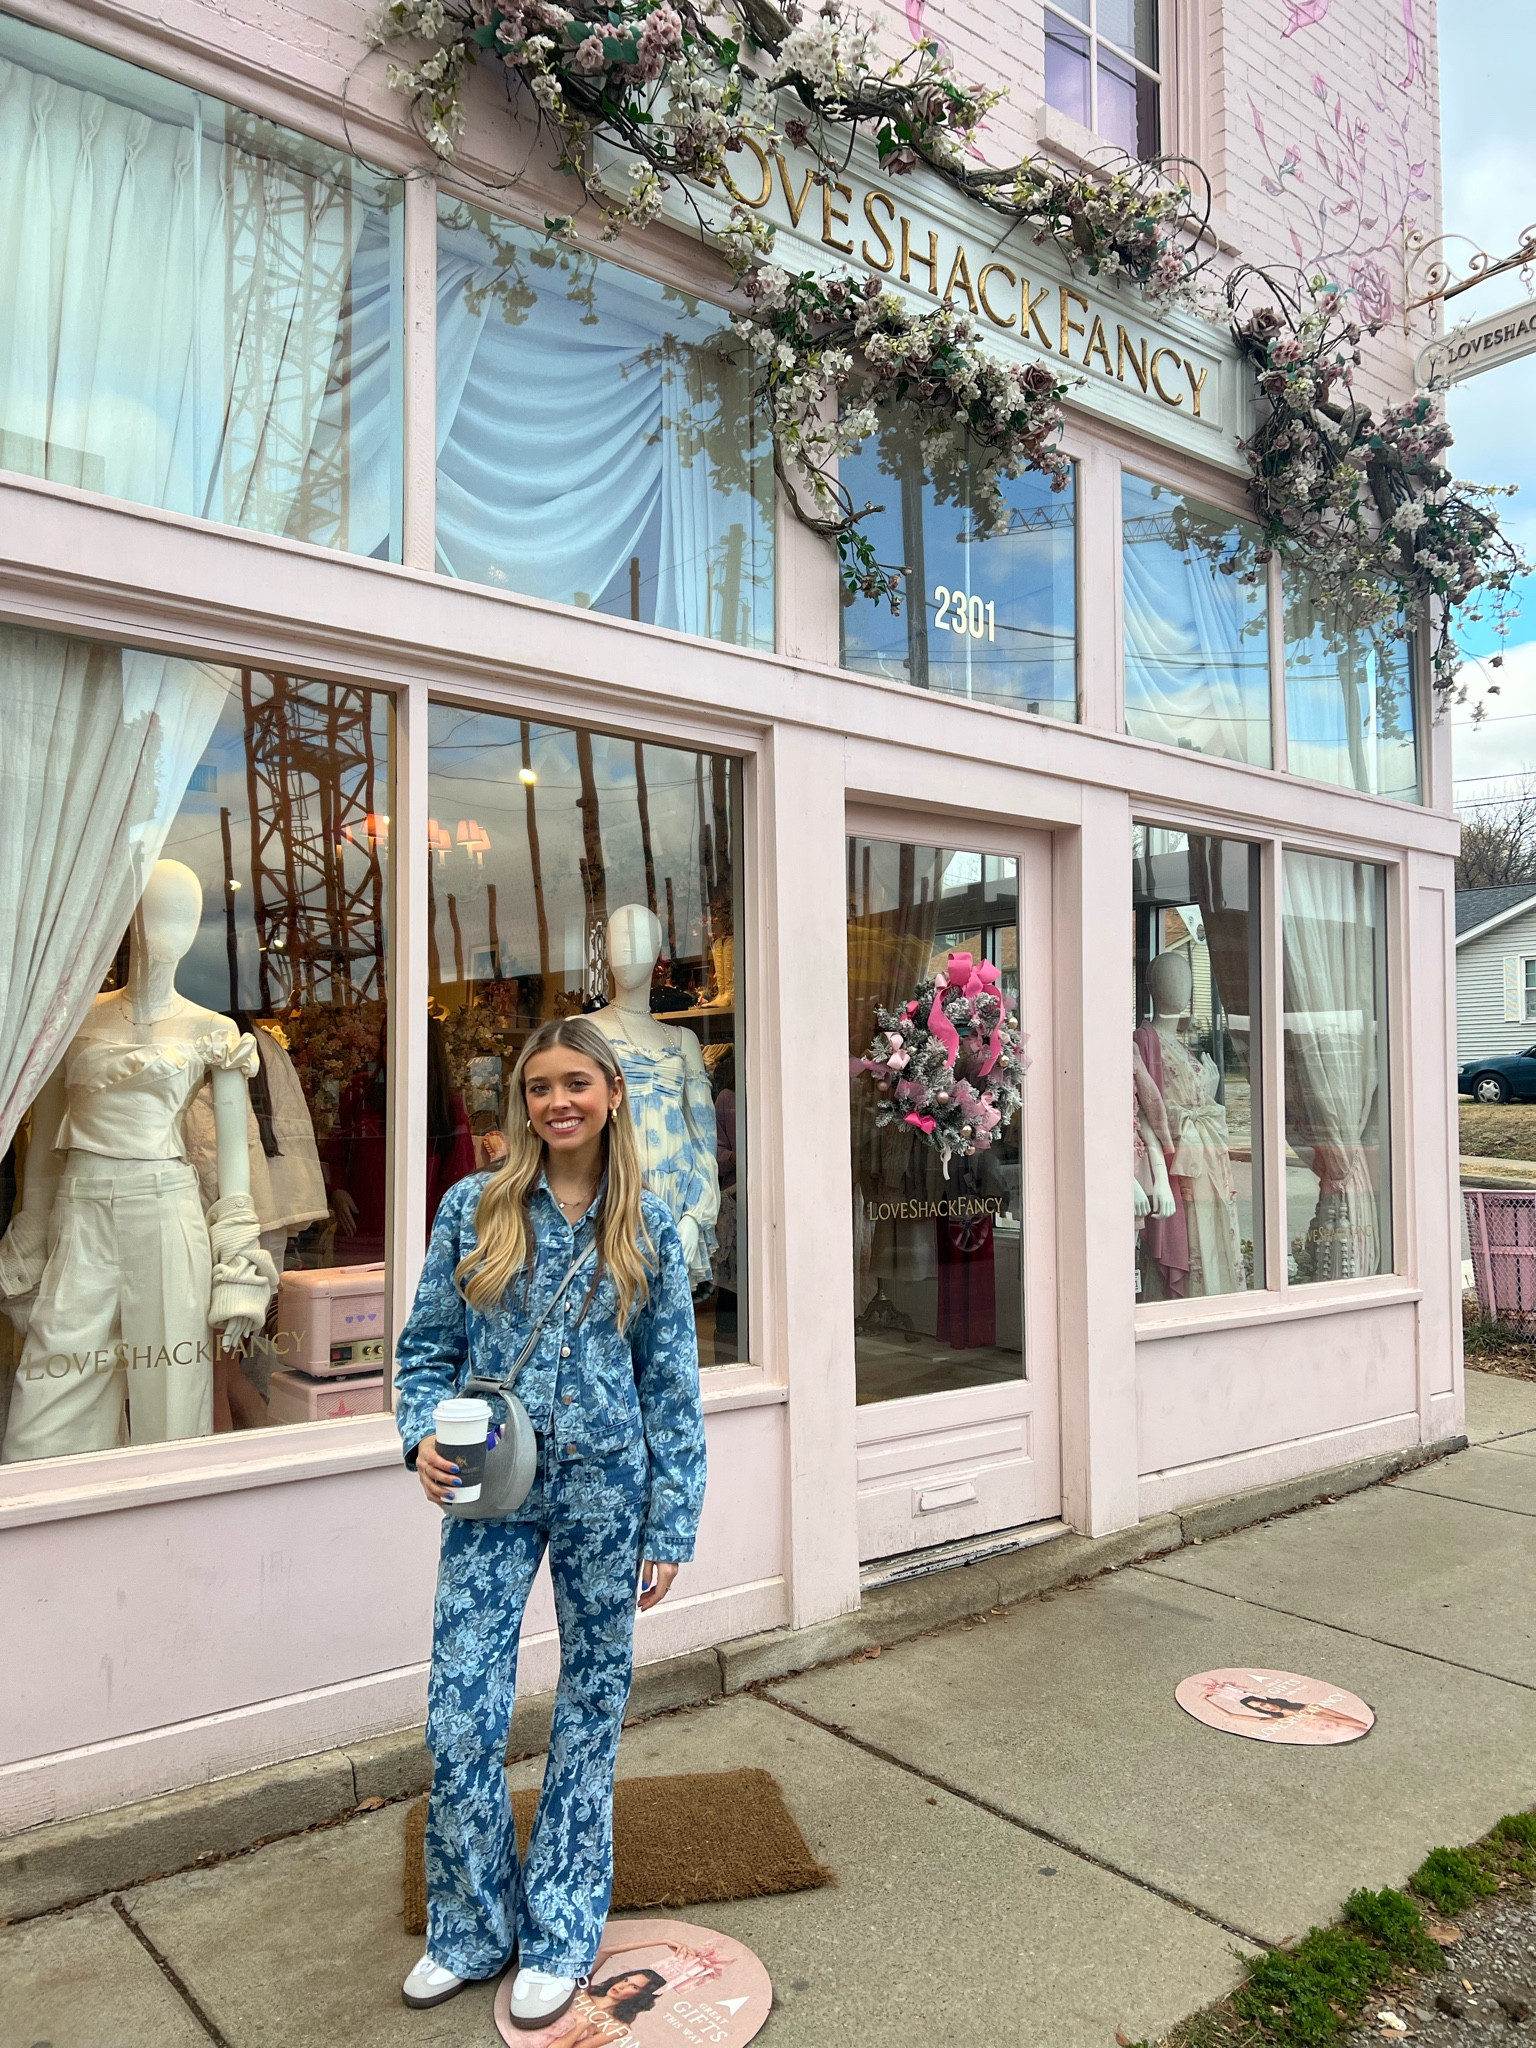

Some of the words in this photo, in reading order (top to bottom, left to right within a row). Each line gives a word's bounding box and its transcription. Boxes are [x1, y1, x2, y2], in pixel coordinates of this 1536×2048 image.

[697, 131, 1207, 418] OVESHACKFANCY
[934, 585, 995, 643] 2301
[869, 1196, 1003, 1221] LOVESHACKFANCY
[24, 1330, 307, 1382] LOVESHACKFANCY
[1267, 1679, 1302, 1695] GIFTS
[1252, 1692, 1348, 1739] LOVESHACKFANCY
[573, 1989, 641, 2048] HACKFA
[663, 2012, 684, 2029] THIS
[682, 2027, 704, 2045] WAY
[673, 2001, 729, 2042] GIFTS
[699, 2002, 729, 2025] GREAT
